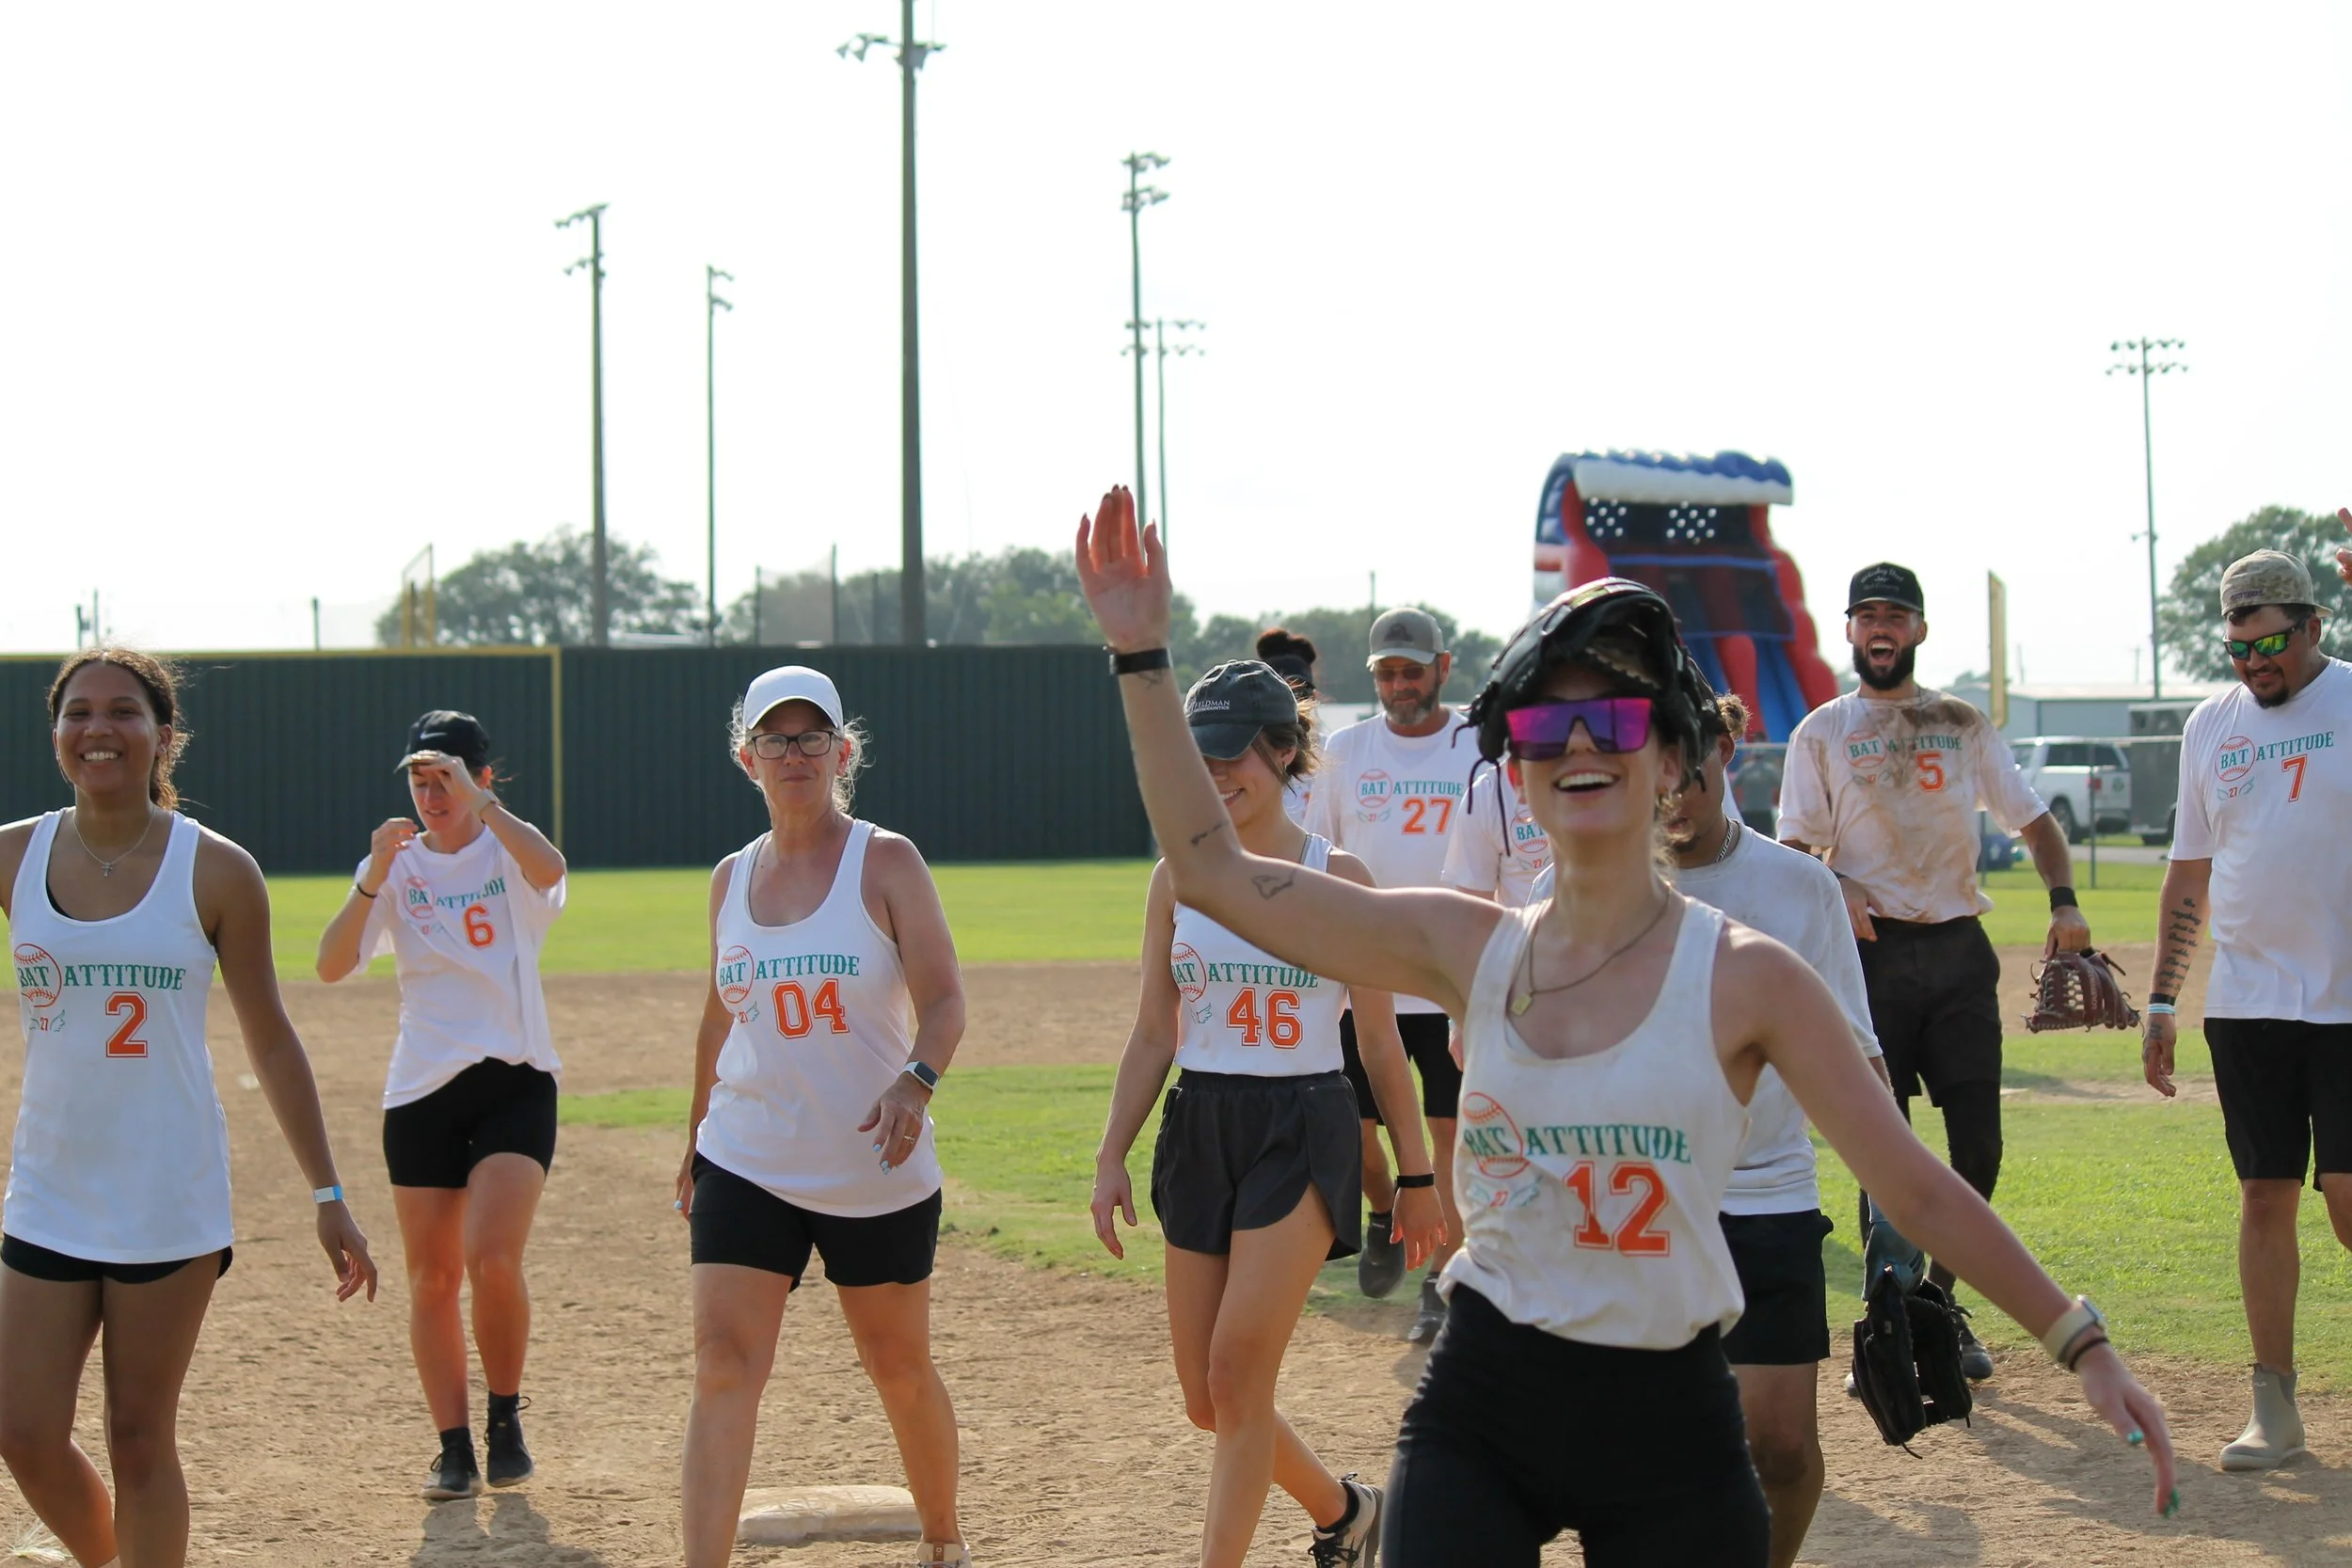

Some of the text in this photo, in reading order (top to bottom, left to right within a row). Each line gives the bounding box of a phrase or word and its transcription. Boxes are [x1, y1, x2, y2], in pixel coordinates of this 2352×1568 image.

[1850, 740, 1880, 758] BAT
[2220, 731, 2334, 769] BAT ATTITUDE
[1361, 781, 1464, 797] BAT ATTITUDE
[1915, 751, 1946, 793] 5
[2281, 753, 2308, 803] 7
[2229, 786, 2238, 799] 27
[1402, 797, 1453, 834] 27
[1533, 859, 1542, 869] 27
[464, 903, 496, 949] 6
[63, 964, 186, 990] ATTITUDE
[720, 954, 860, 987] BAT ATTITUDE
[105, 991, 148, 1057] 2
[771, 978, 850, 1039] 04
[1226, 988, 1303, 1049] 46
[1464, 1124, 1691, 1164] BAT ATTITUDE
[1490, 1190, 1508, 1208] 27
[1563, 1161, 1670, 1257] 12
